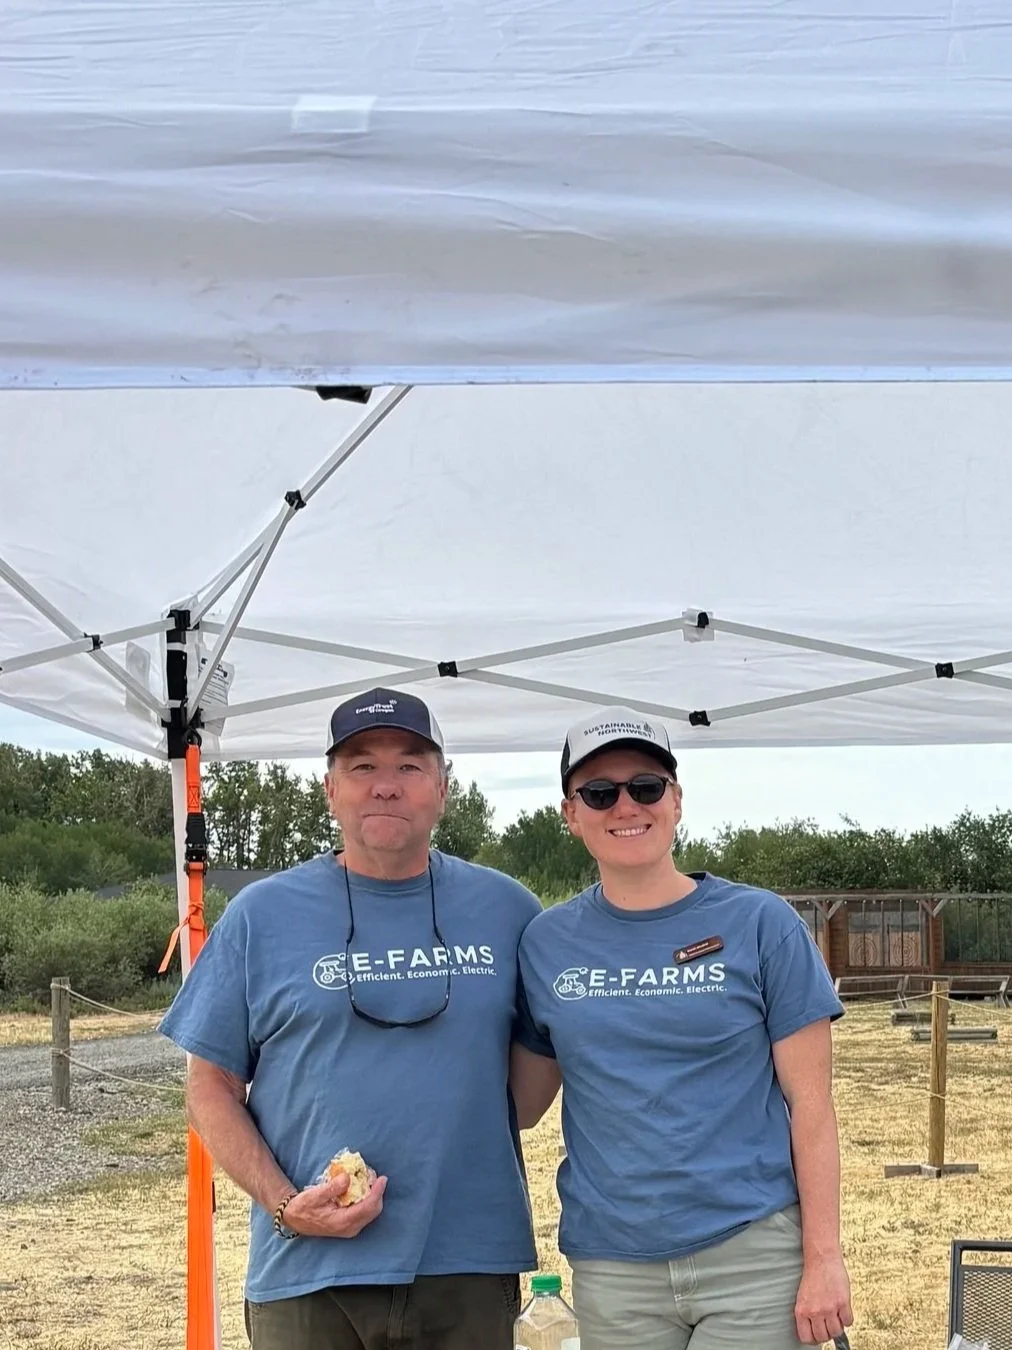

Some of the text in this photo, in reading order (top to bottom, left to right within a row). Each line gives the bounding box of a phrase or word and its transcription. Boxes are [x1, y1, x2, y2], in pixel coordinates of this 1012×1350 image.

[584, 722, 641, 736] SUSTAINABLE
[598, 728, 652, 739] NORTHWEST
[351, 945, 495, 972] E-FARMS
[356, 972, 405, 984] Efficient.
[462, 966, 498, 977] Electric.
[588, 962, 727, 988] E-FARMS
[588, 984, 728, 998] Efficient. Economic. Electric.
